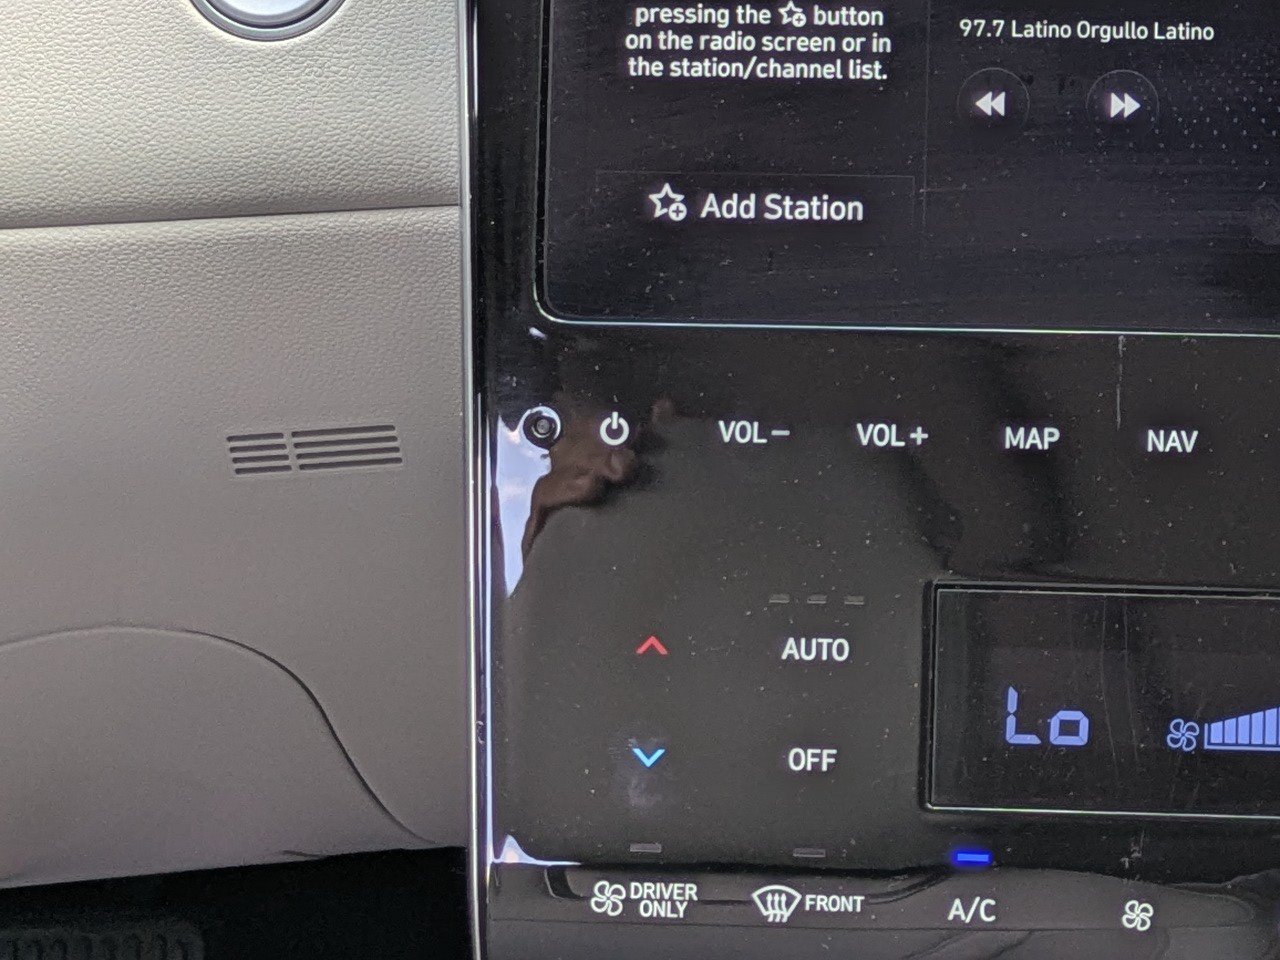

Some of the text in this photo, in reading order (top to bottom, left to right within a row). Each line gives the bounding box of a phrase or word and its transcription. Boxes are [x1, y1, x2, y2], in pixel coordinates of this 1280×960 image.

[635, 3, 884, 29] pressing the button
[625, 29, 892, 53] on the radio screen or in
[959, 18, 1215, 43] 97.7 Latino Orgullo Latino
[627, 55, 888, 80] the station/channel list.
[700, 193, 864, 221] Add Station
[1004, 426, 1061, 450] MAP
[1147, 429, 1199, 453] NAV
[781, 637, 850, 662] AUTO
[788, 747, 838, 772] OFF
[629, 881, 698, 901] DRIVER
[805, 894, 866, 913] FRONT
[639, 899, 688, 919] ONLY
[947, 896, 996, 924] A/C
